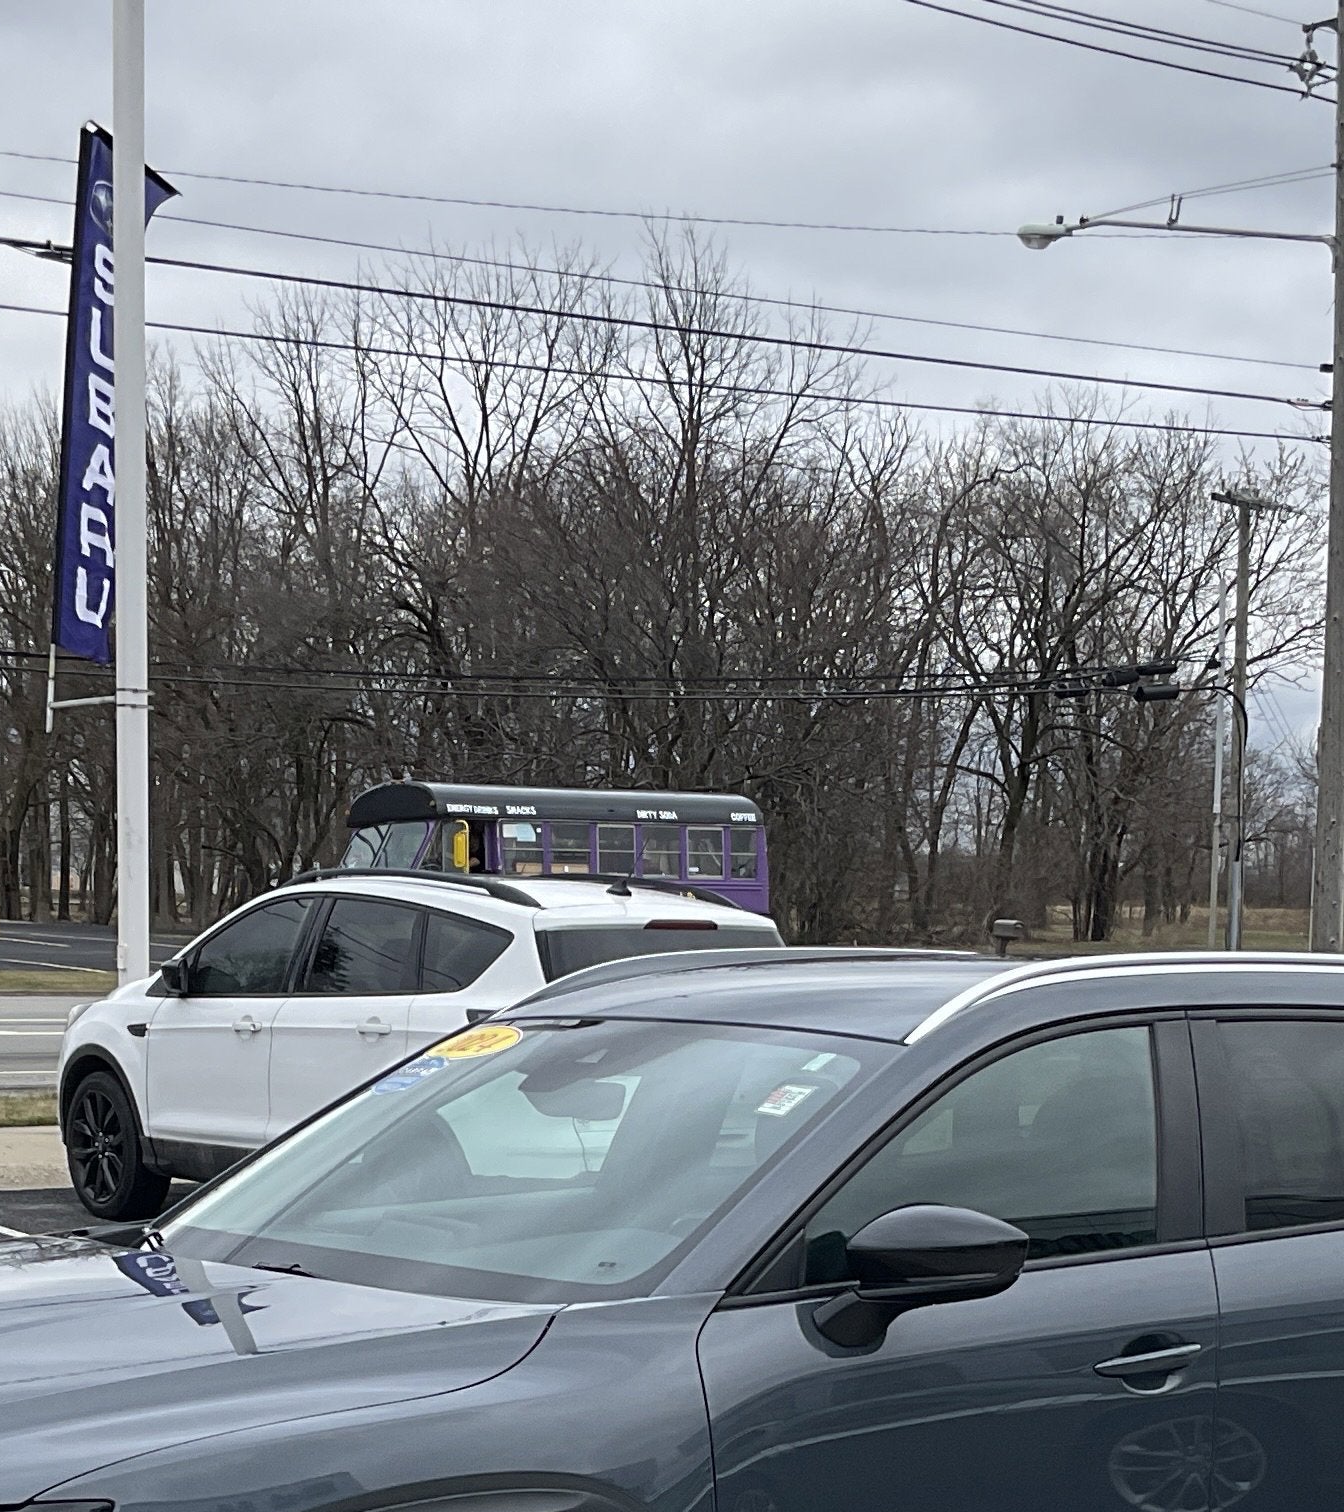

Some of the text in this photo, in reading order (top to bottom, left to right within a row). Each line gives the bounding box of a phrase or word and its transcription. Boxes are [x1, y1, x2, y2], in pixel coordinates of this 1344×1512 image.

[446, 803, 473, 813] ENERGY
[505, 805, 537, 815] SNACKS
[636, 809, 678, 820] DIRTY SODA
[730, 812, 757, 822] COFFEE
